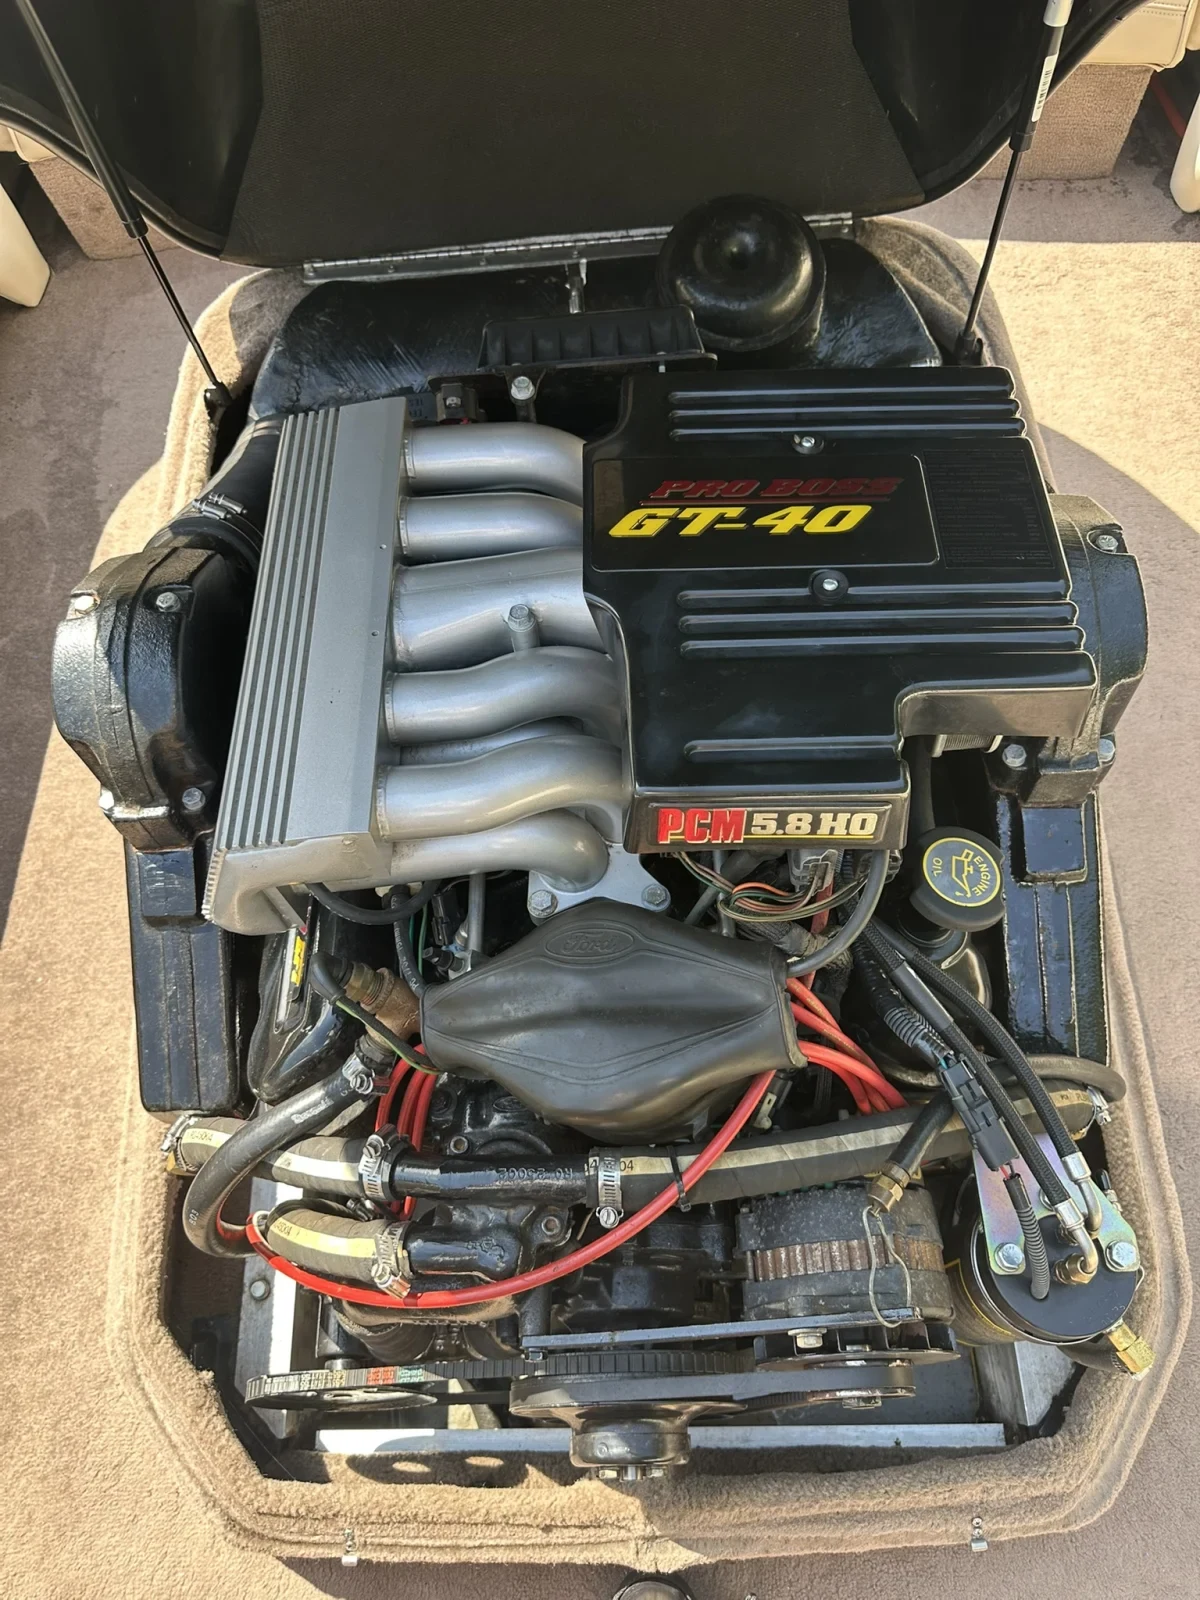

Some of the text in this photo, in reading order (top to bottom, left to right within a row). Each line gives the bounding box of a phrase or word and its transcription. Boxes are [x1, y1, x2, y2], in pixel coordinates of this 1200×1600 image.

[649, 477, 904, 499] PRO BOSS
[608, 504, 875, 538] GT-40
[657, 808, 879, 844] PCM 5.8 HO
[931, 857, 943, 877] OIL
[972, 855, 991, 896] ENGINE
[561, 931, 620, 954] Ford
